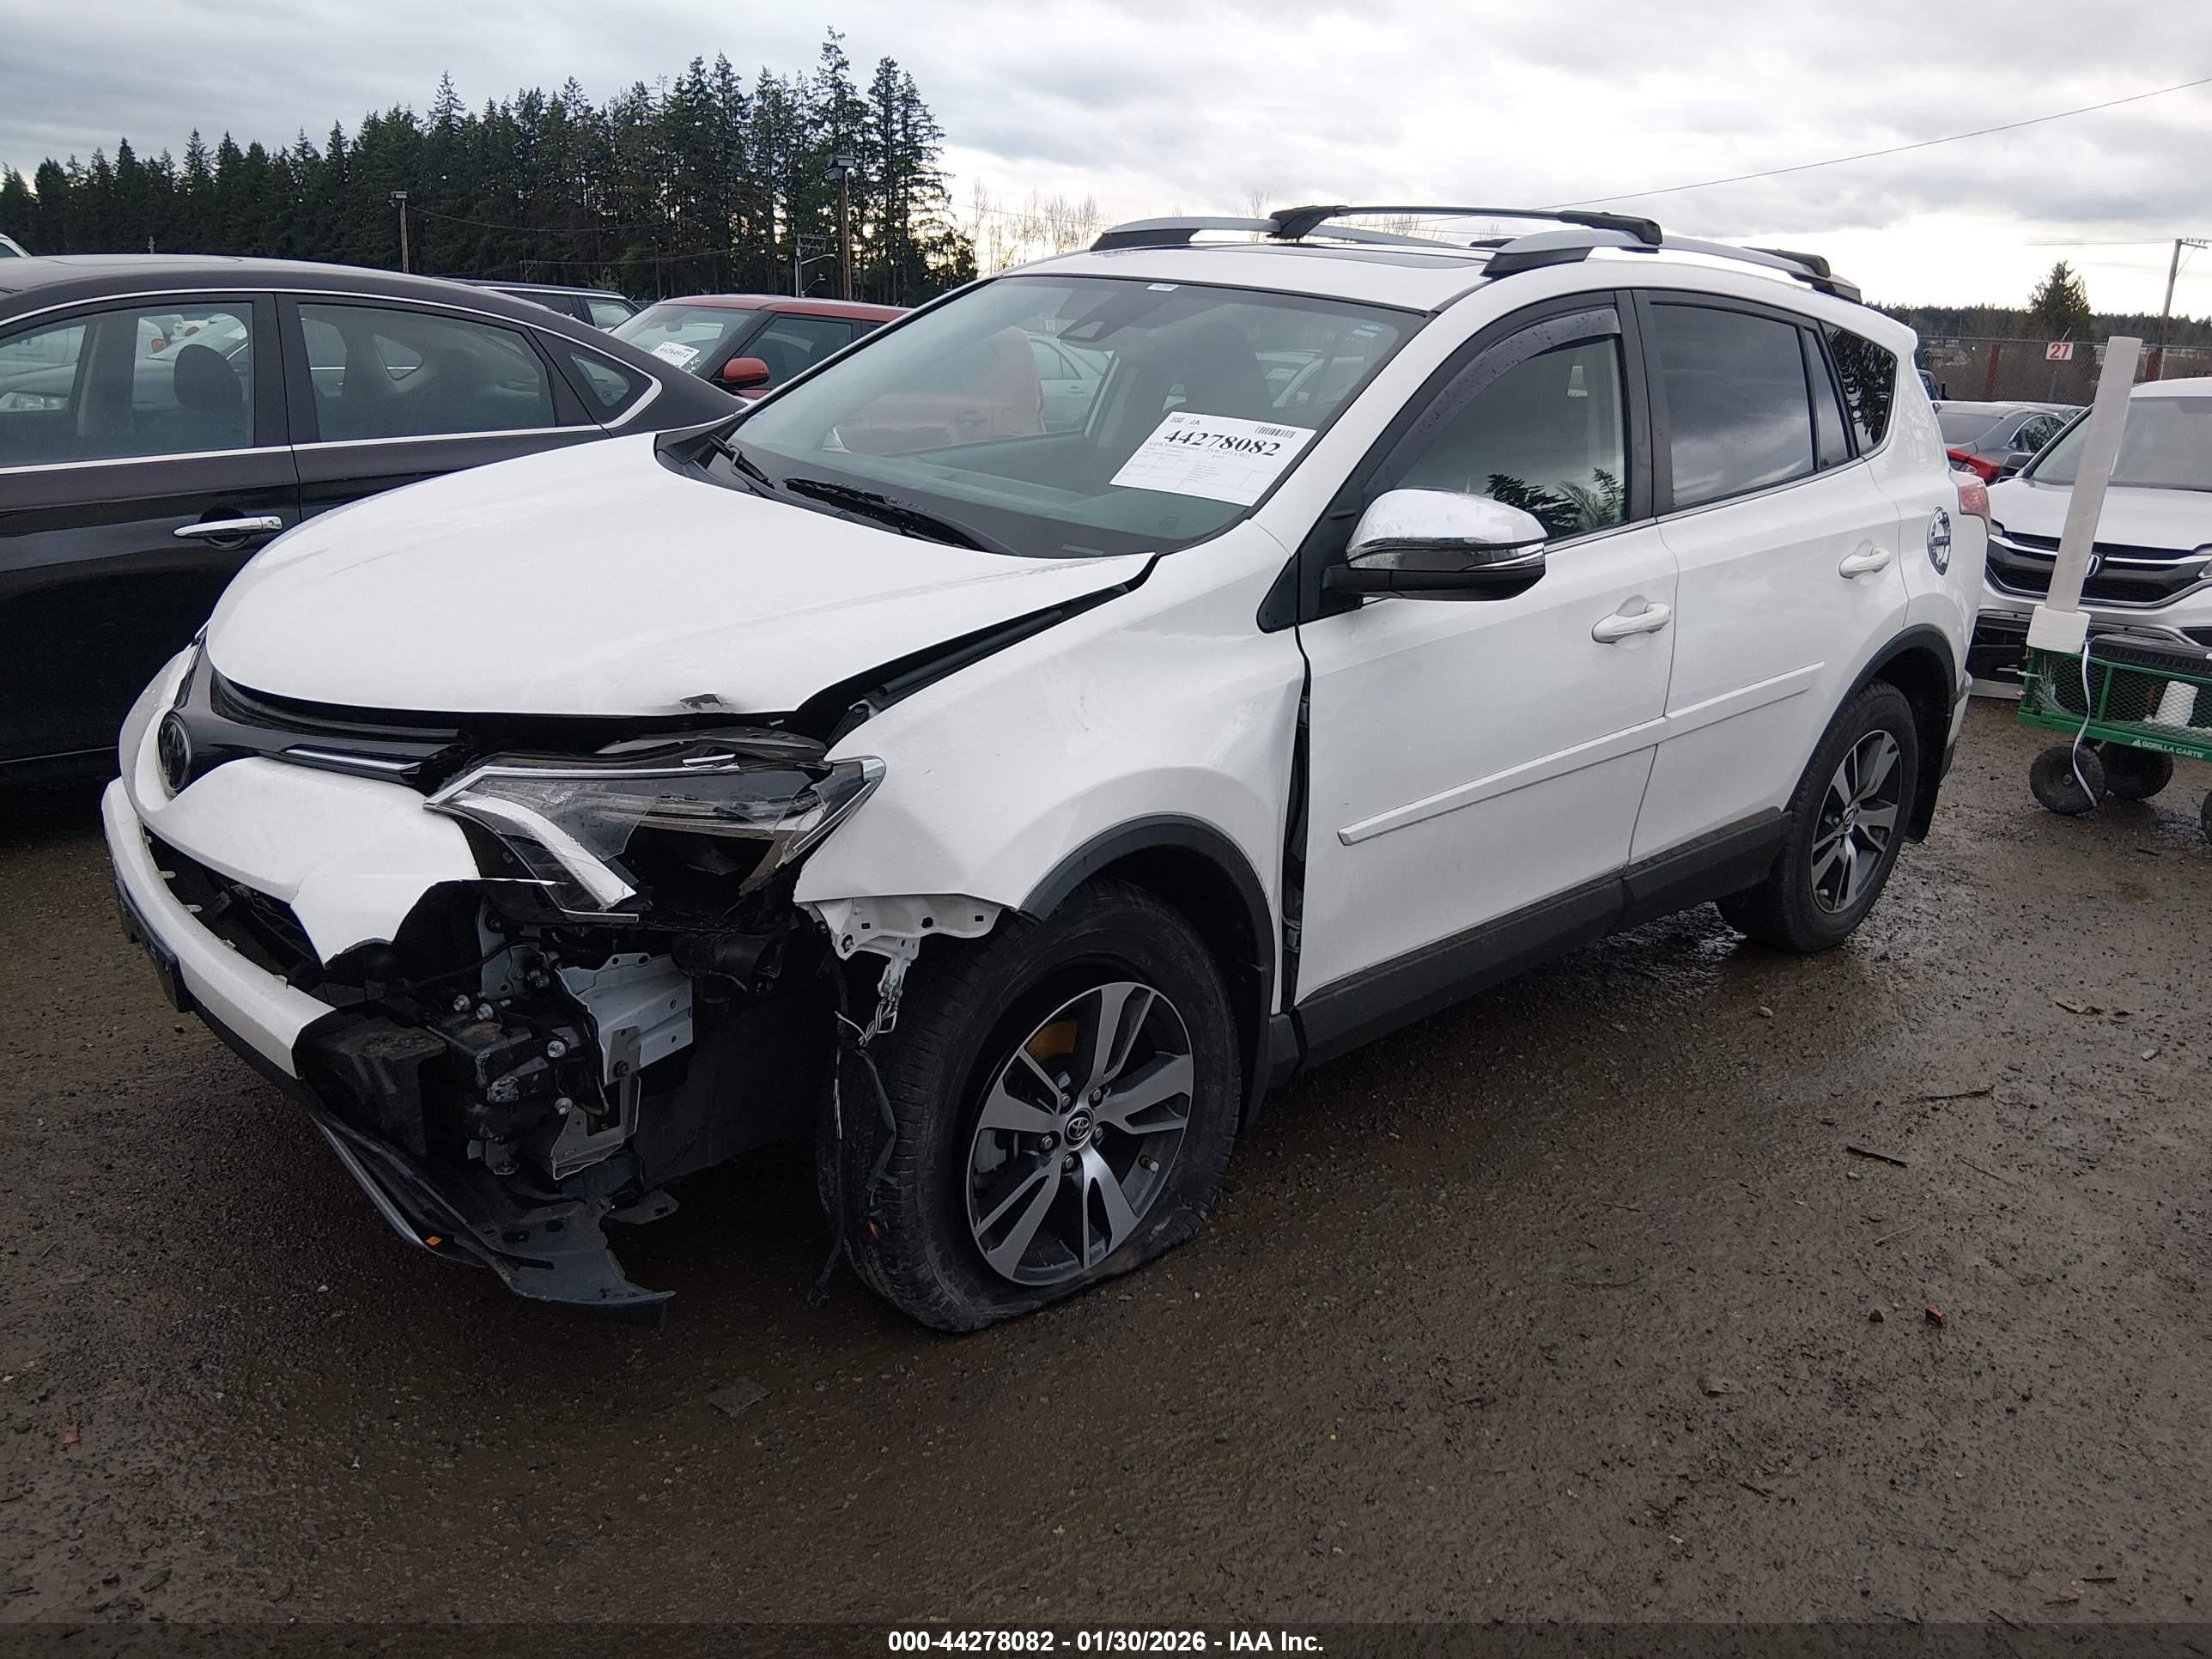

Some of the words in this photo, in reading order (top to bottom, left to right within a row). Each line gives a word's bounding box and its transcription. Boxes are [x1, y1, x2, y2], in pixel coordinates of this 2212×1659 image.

[2049, 343, 2070, 359] 27
[1164, 429, 1282, 457] 44278082
[2142, 740, 2175, 753] GORILLA
[2175, 747, 2204, 758] CARTS
